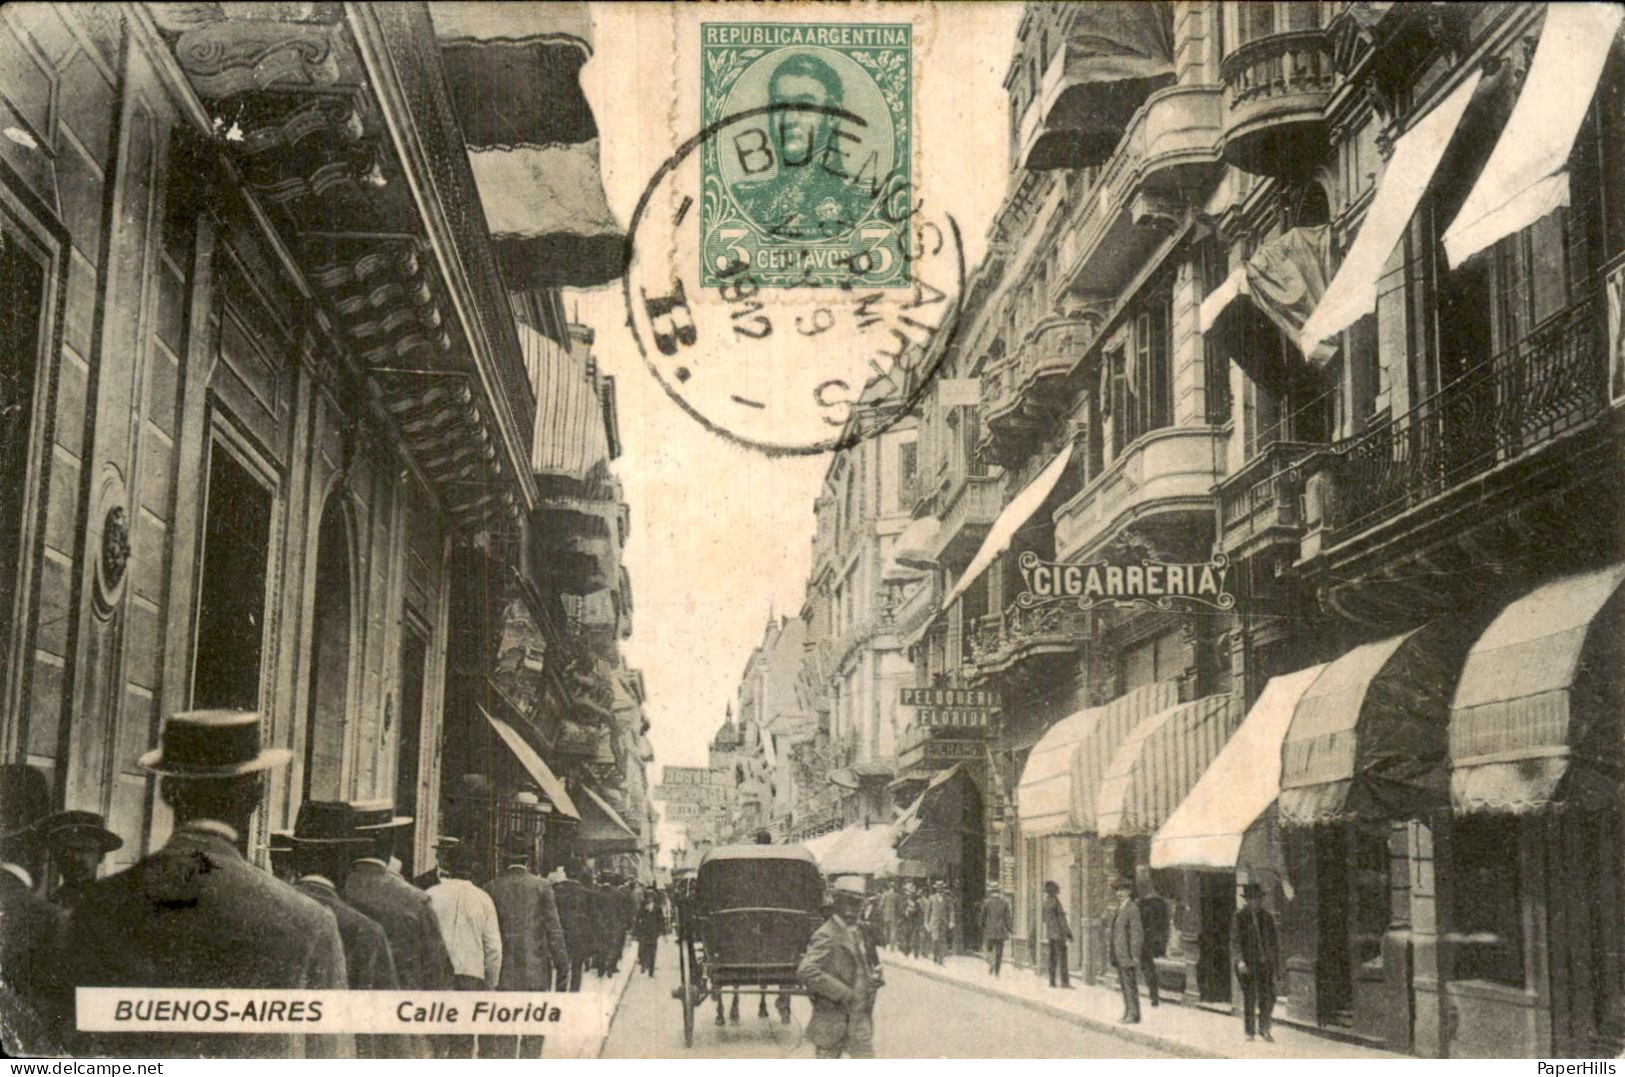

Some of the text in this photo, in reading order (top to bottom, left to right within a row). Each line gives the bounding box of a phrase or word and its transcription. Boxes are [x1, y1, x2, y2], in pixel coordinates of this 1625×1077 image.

[717, 229, 750, 274] 3
[757, 249, 851, 270] CENTAVOS
[858, 228, 893, 274] 3
[1034, 566, 1217, 595] CIGARRERIA
[921, 711, 987, 726] FLORIDA
